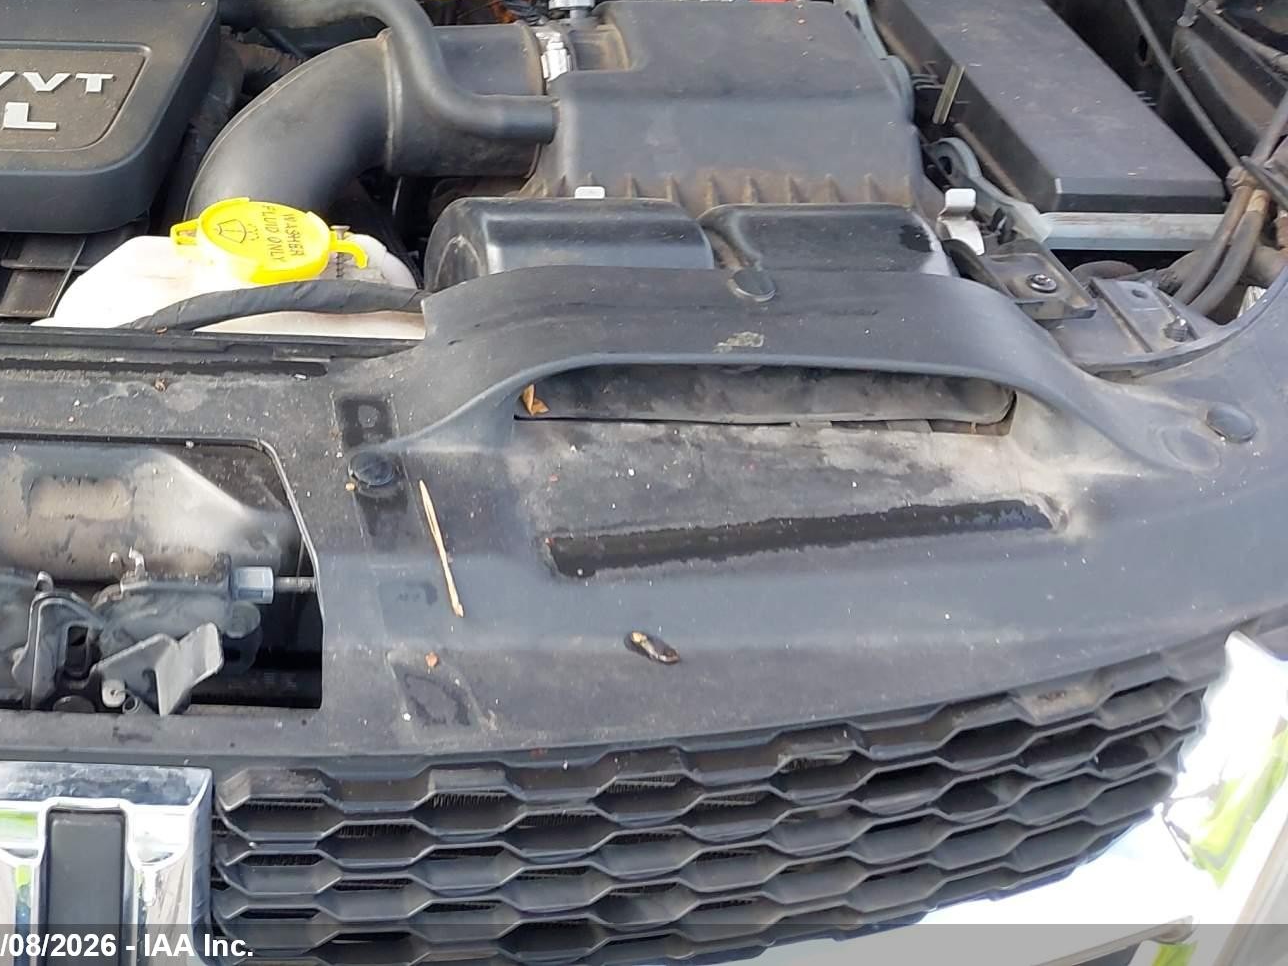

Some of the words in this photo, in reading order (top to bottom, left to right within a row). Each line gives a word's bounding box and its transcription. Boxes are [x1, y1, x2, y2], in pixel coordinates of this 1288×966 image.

[2, 101, 58, 130] L
[262, 205, 280, 233] FLUID
[266, 236, 287, 263] ONLY
[281, 214, 305, 257] WASHER
